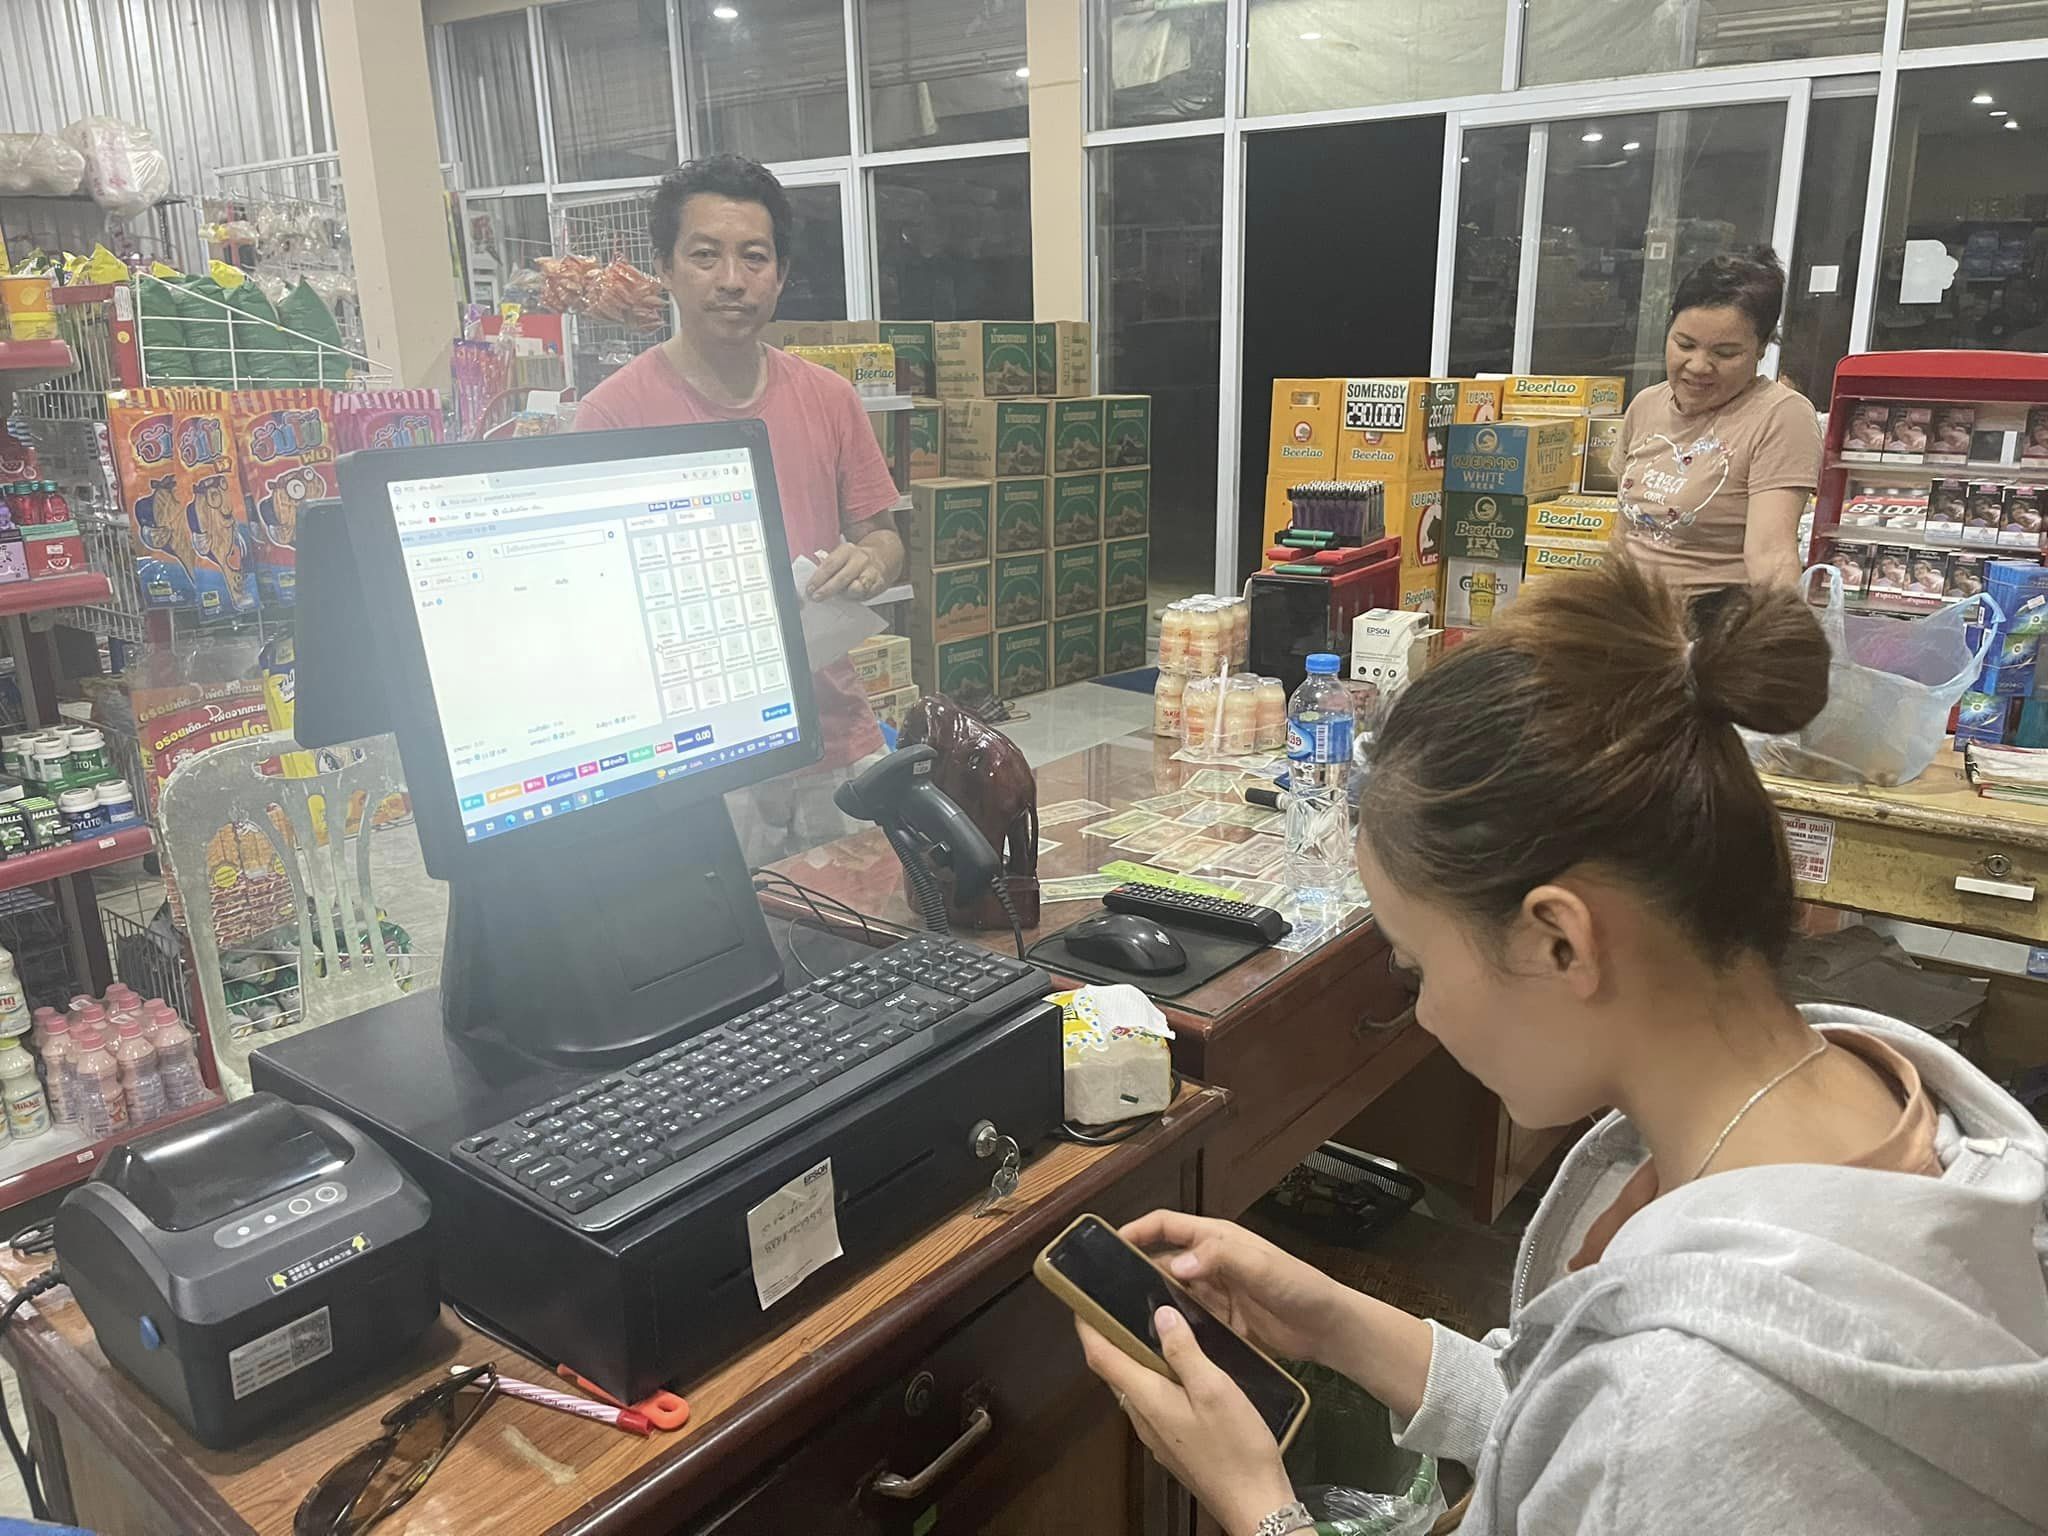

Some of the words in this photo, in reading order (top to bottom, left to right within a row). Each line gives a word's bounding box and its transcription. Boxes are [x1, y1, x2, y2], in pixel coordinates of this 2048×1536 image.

[1347, 384, 1406, 399] SOMERSBY
[1516, 380, 1576, 394] Beerlao
[1347, 402, 1404, 427] 290,000
[1590, 438, 1616, 447] Beer
[1283, 447, 1323, 458] Beerlao
[1352, 450, 1394, 461] Beerlao
[1537, 448, 1563, 465] WHITE
[1463, 471, 1505, 485] WHITE
[1537, 510, 1602, 527] Beerlao
[1456, 521, 1514, 538] Beerlao
[1466, 538, 1500, 550] IPA
[1459, 576, 1509, 594] Carlsberg
[1366, 626, 1390, 635] EPSON
[695, 729, 711, 741] 0.00
[32, 808, 59, 820] HALLS
